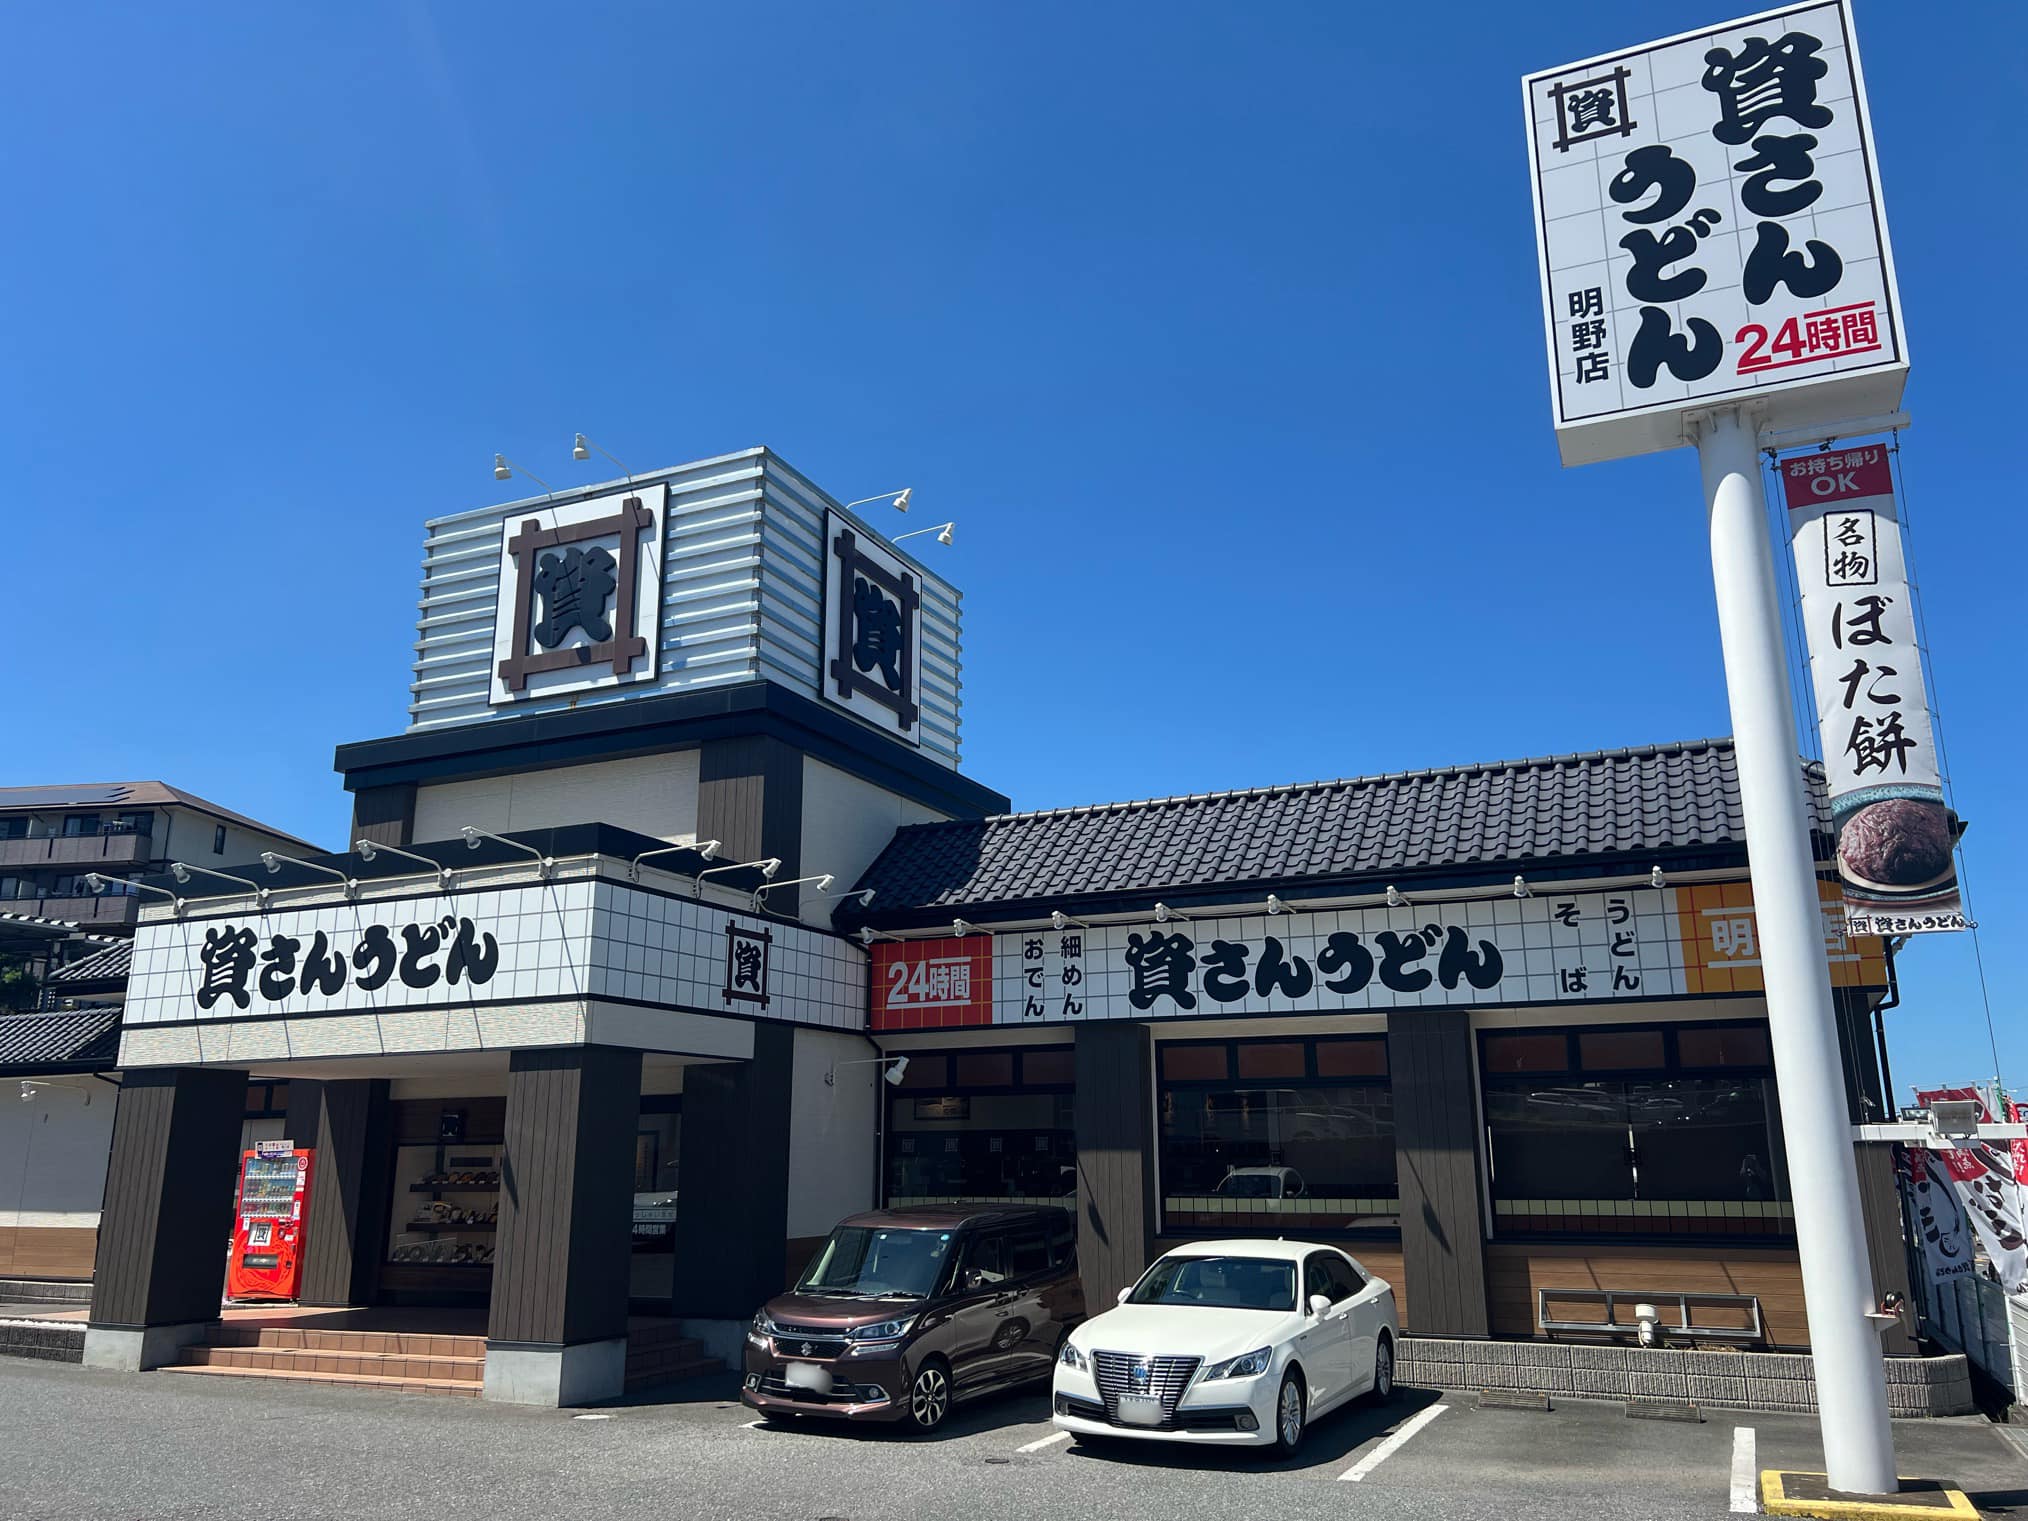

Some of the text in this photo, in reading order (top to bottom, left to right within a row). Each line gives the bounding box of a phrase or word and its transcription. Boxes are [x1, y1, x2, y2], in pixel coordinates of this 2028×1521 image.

[1567, 89, 1617, 134] 資
[1702, 32, 1844, 306] 資さん
[1608, 144, 1724, 389] うどん
[1567, 286, 1610, 385] 明野店
[1735, 310, 1880, 371] 24時間
[1788, 447, 1880, 478] お持ち帰り
[1810, 475, 1862, 496] OK
[1832, 517, 1869, 580] 名物
[1831, 595, 1918, 777] ぼた餅
[197, 914, 500, 1010] 資さんうどん
[886, 960, 971, 1003] 24時間
[1024, 937, 1045, 1018] おでん
[1061, 934, 1083, 1016] 細めん
[1124, 923, 1505, 1011] 資さんうどん
[1554, 902, 1588, 994] そば
[1606, 898, 1640, 992] うどん
